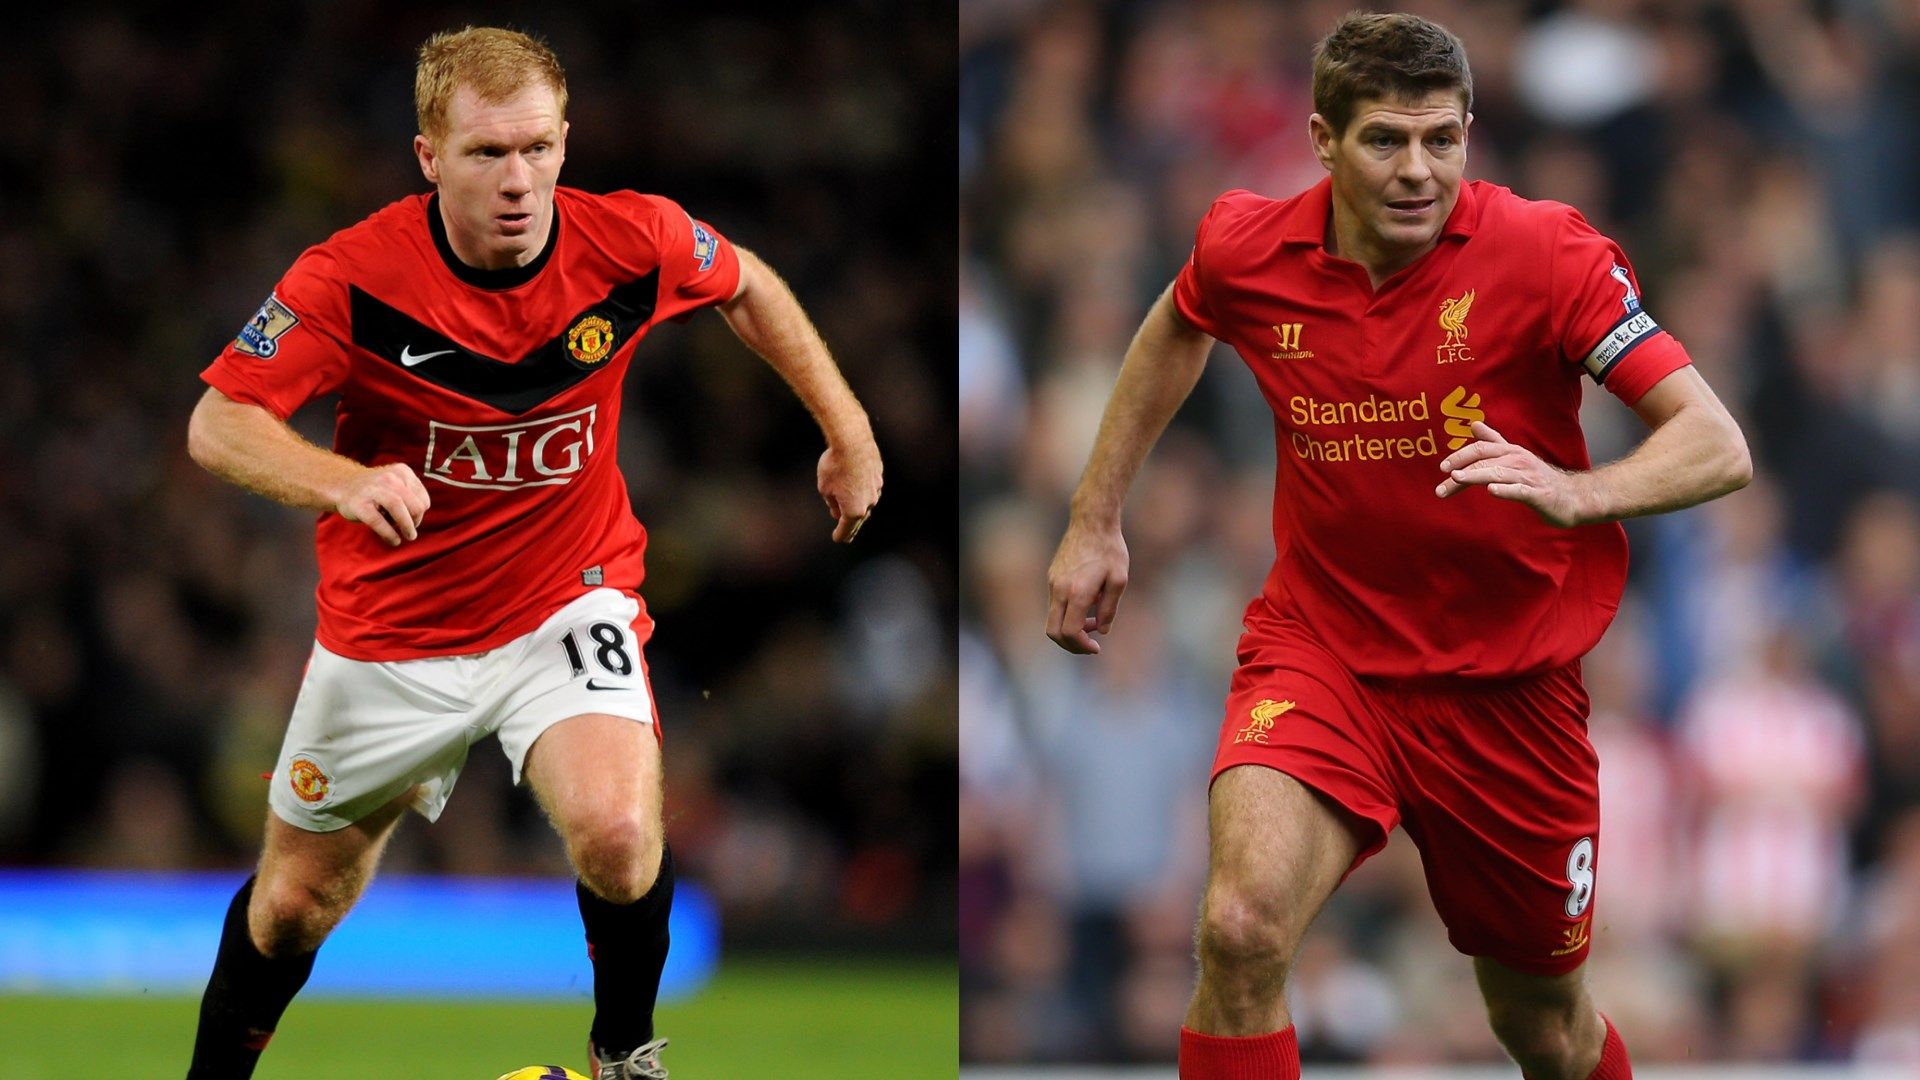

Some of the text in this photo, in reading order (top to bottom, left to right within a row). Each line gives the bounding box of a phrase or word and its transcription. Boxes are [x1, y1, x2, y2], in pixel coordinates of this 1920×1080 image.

[572, 318, 610, 337] MANCHESTER
[580, 349, 606, 360] UNITED
[1596, 341, 1617, 361] PREMIER
[1601, 346, 1620, 365] LEAGUE
[1290, 392, 1430, 425] Standard
[435, 420, 583, 482] AIG
[1292, 428, 1438, 462] Chartered
[559, 620, 633, 680] 18
[1565, 837, 1594, 918] 8
